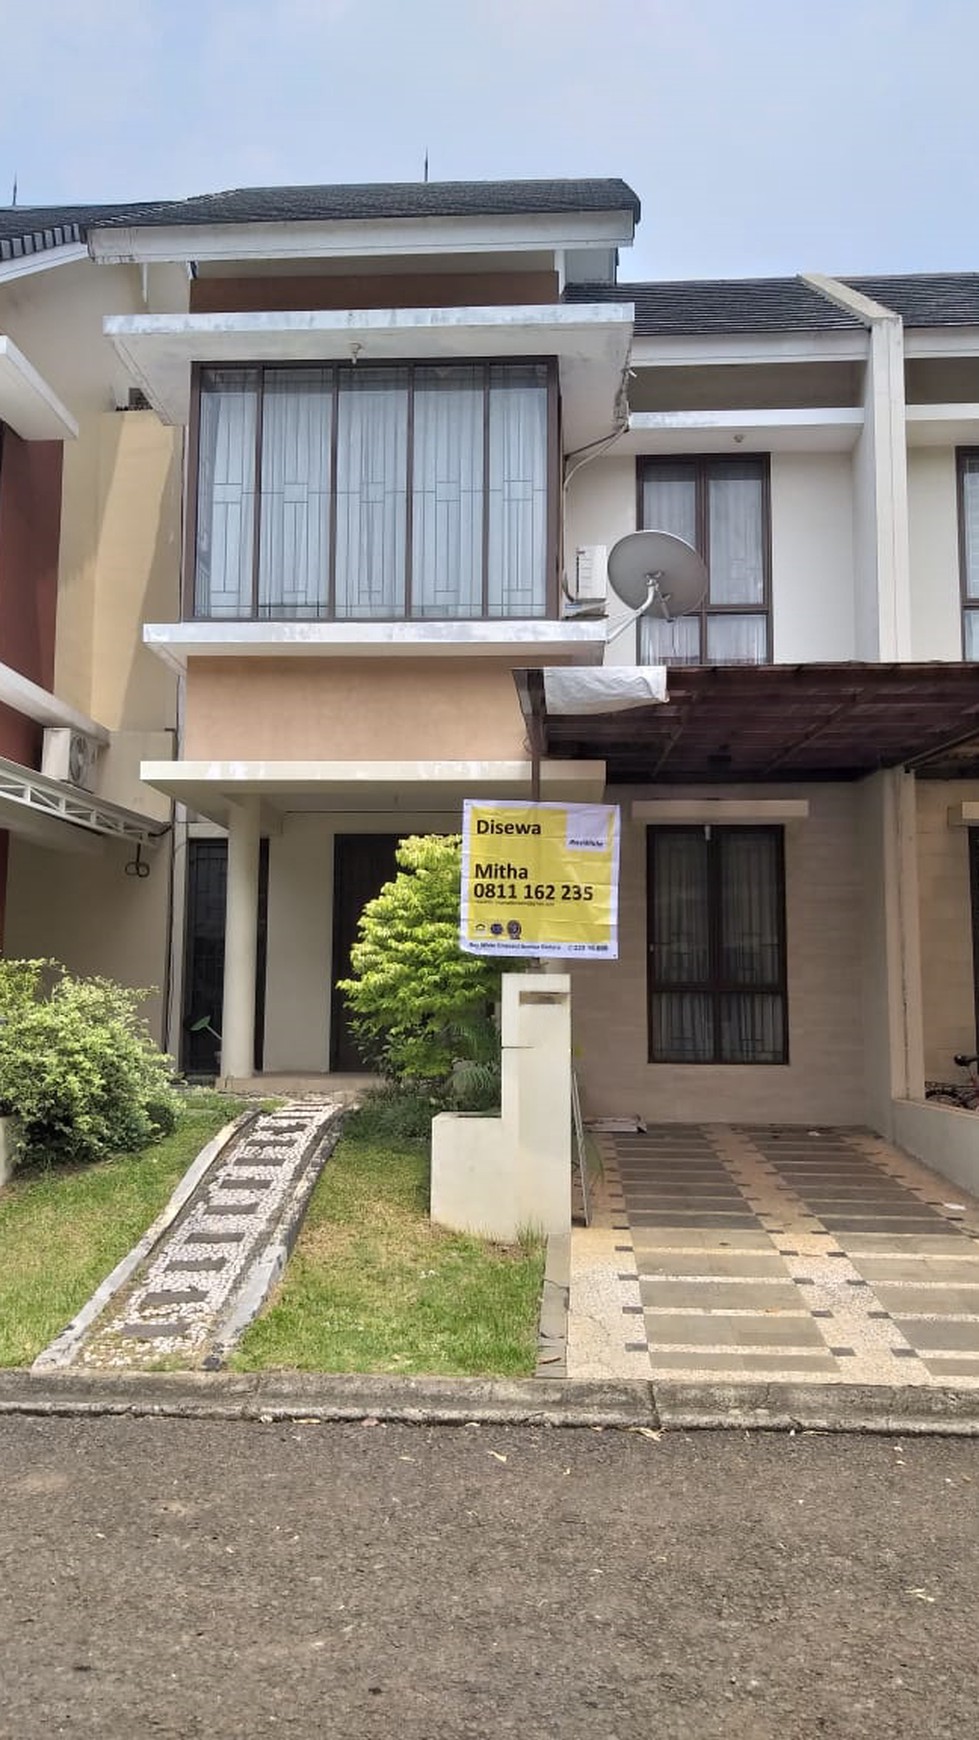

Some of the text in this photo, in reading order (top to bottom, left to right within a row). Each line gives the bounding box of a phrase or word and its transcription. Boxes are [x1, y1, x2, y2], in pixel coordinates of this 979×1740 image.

[476, 819, 542, 835] Disewa
[475, 863, 529, 880] Mitha
[474, 883, 594, 901] 0811 162 235
